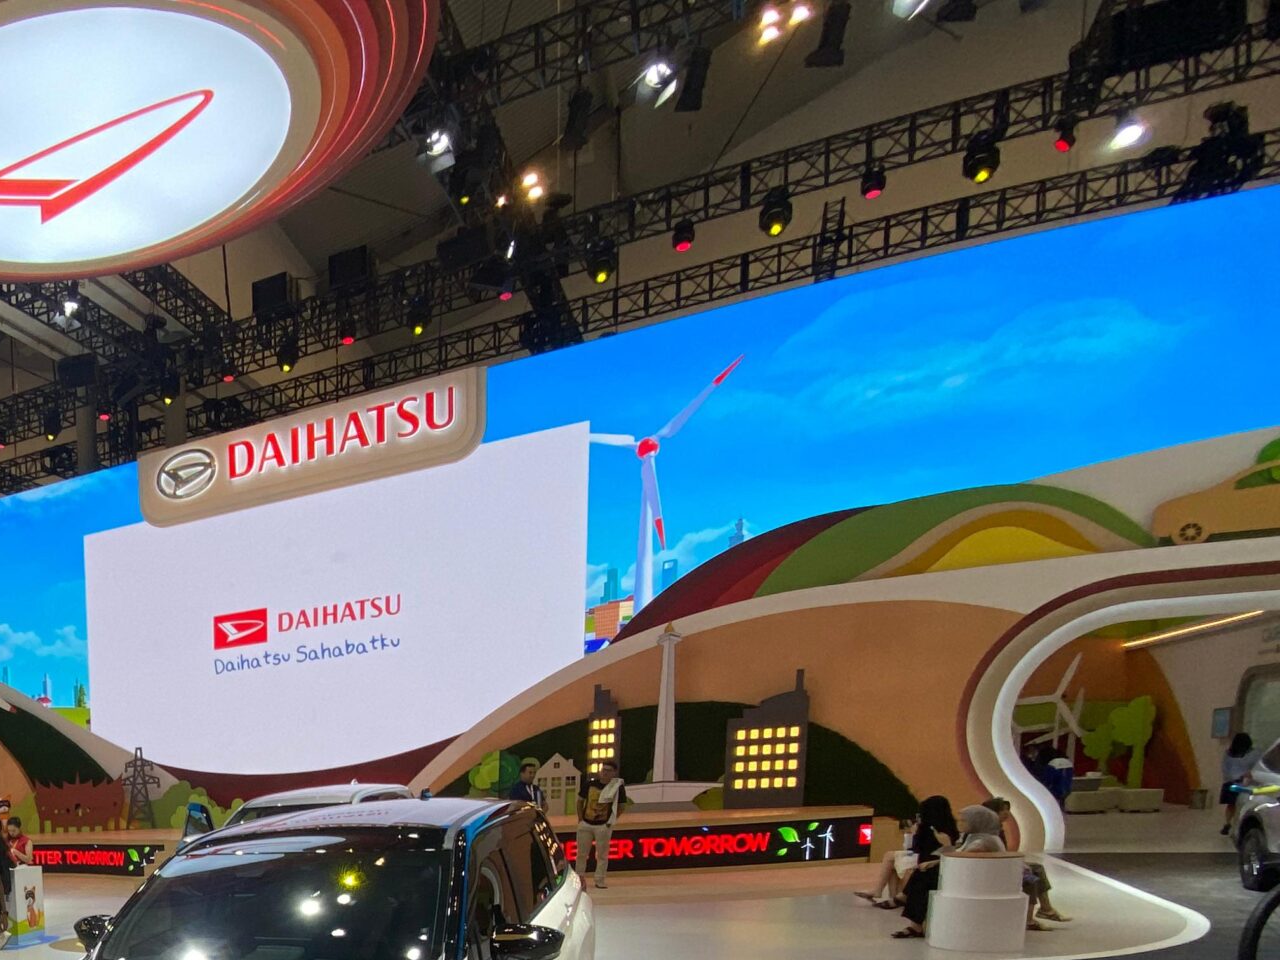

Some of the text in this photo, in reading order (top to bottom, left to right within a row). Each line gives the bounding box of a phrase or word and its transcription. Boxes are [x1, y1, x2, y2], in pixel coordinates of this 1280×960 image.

[227, 386, 454, 480] DAIHATSU
[277, 593, 401, 633] DAIHATSU
[213, 634, 401, 675] Daihatsu Sahabatku
[65, 849, 125, 867] TOMORROW
[639, 832, 771, 858] TOMORROW
